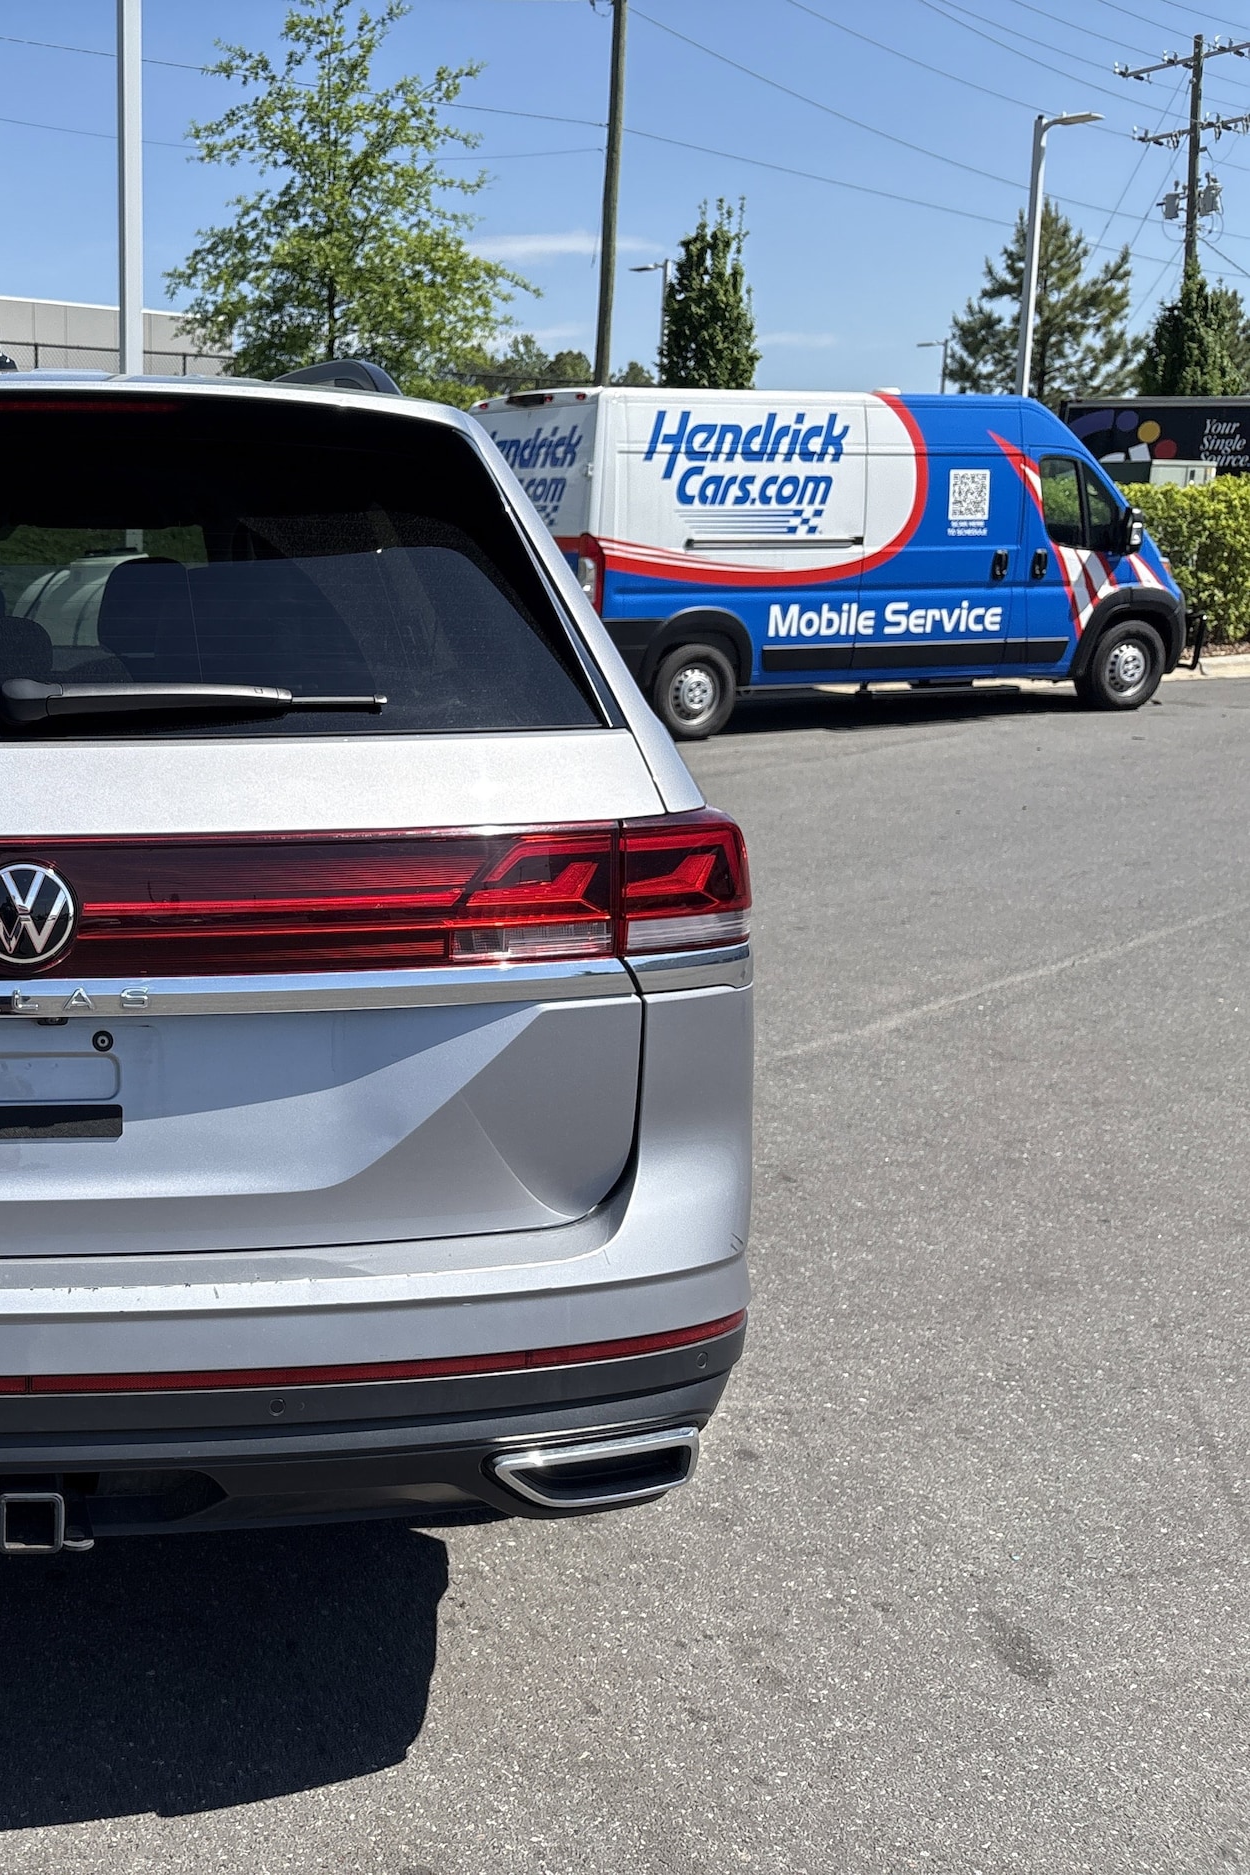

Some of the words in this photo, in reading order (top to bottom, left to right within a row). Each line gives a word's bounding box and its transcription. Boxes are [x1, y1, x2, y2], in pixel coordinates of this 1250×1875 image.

[643, 410, 850, 479] Hendrick
[1200, 433, 1246, 455] Single
[1204, 418, 1240, 434] Your
[491, 425, 582, 469] ndrick
[676, 466, 833, 505] Cars.com
[767, 602, 876, 637] Mobile
[883, 600, 1003, 635] Service
